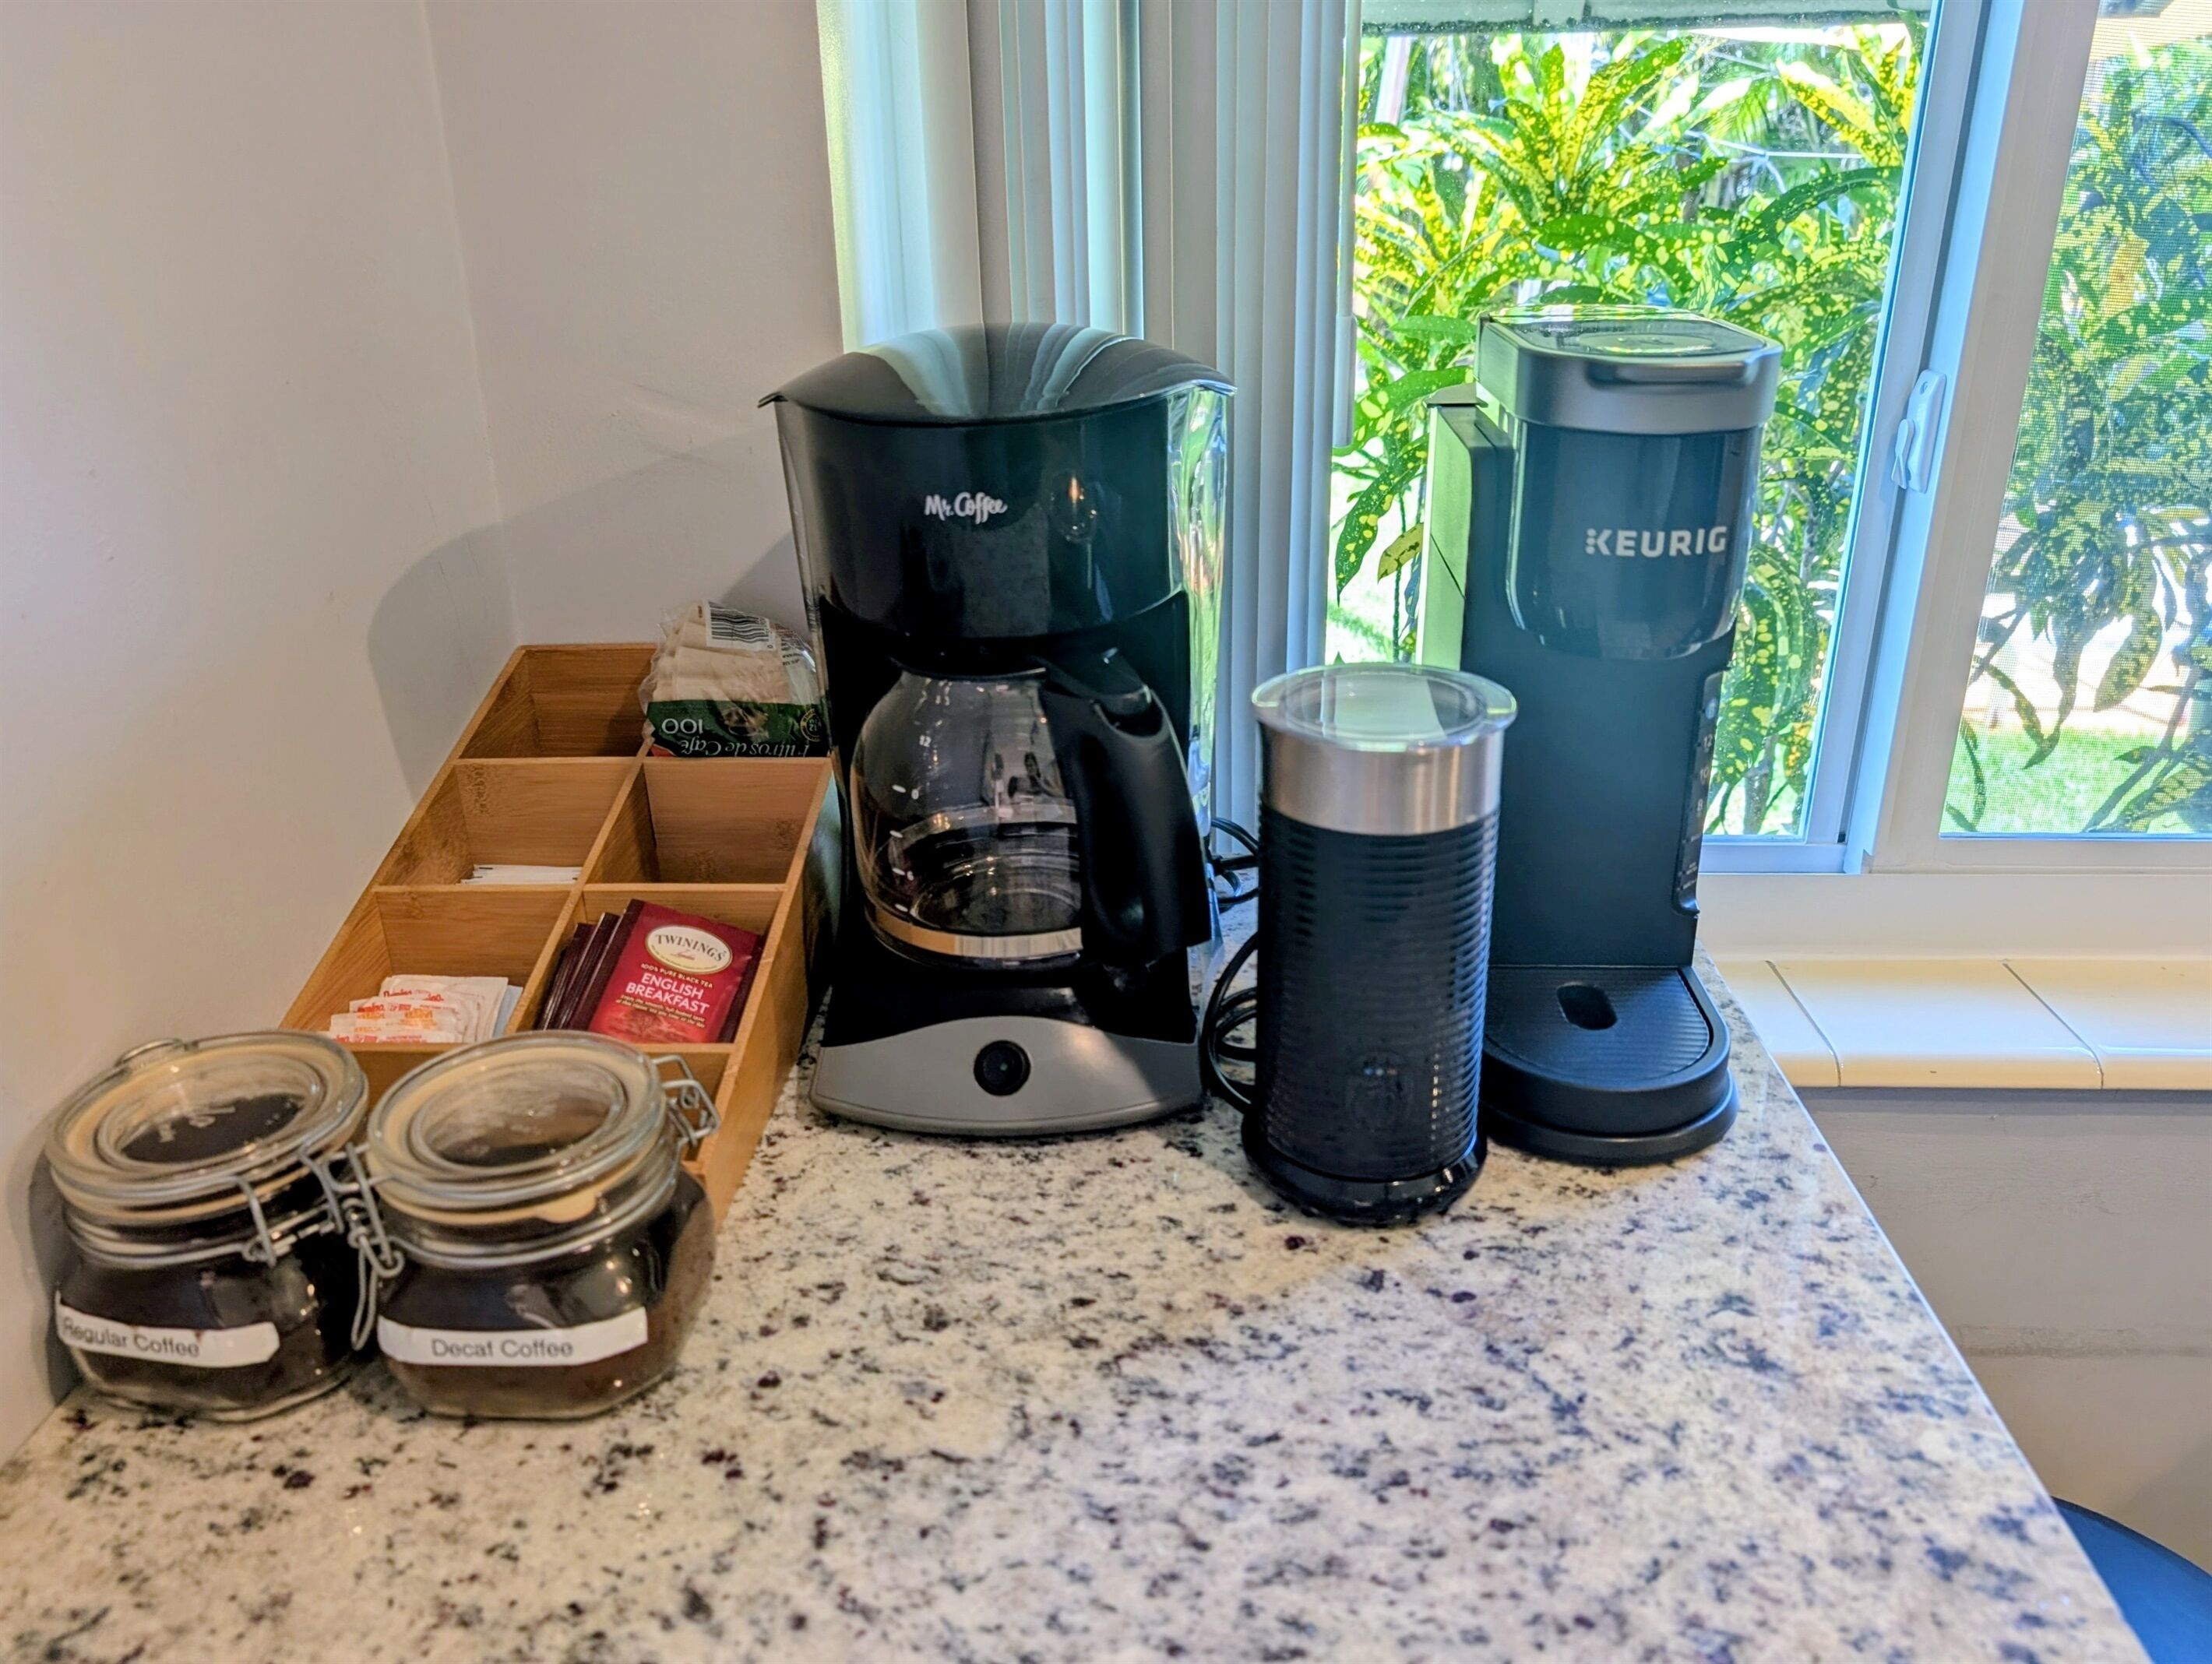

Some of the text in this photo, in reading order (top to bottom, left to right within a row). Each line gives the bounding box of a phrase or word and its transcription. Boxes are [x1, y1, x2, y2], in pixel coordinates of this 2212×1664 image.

[924, 491, 1009, 525] Mr. Coffee
[1585, 526, 1728, 558] KEURIG
[662, 718, 703, 734] 100
[725, 741, 747, 757] de
[655, 934, 724, 962] TWININGS
[641, 973, 704, 999] ENGLISH
[660, 967, 677, 977] PURE
[678, 973, 699, 984] BLACK
[701, 980, 713, 988] TEA
[625, 982, 710, 1014] BREAKFAST
[62, 1316, 200, 1358] Regular Coffee
[431, 1338, 574, 1358] Decaf Coffee
